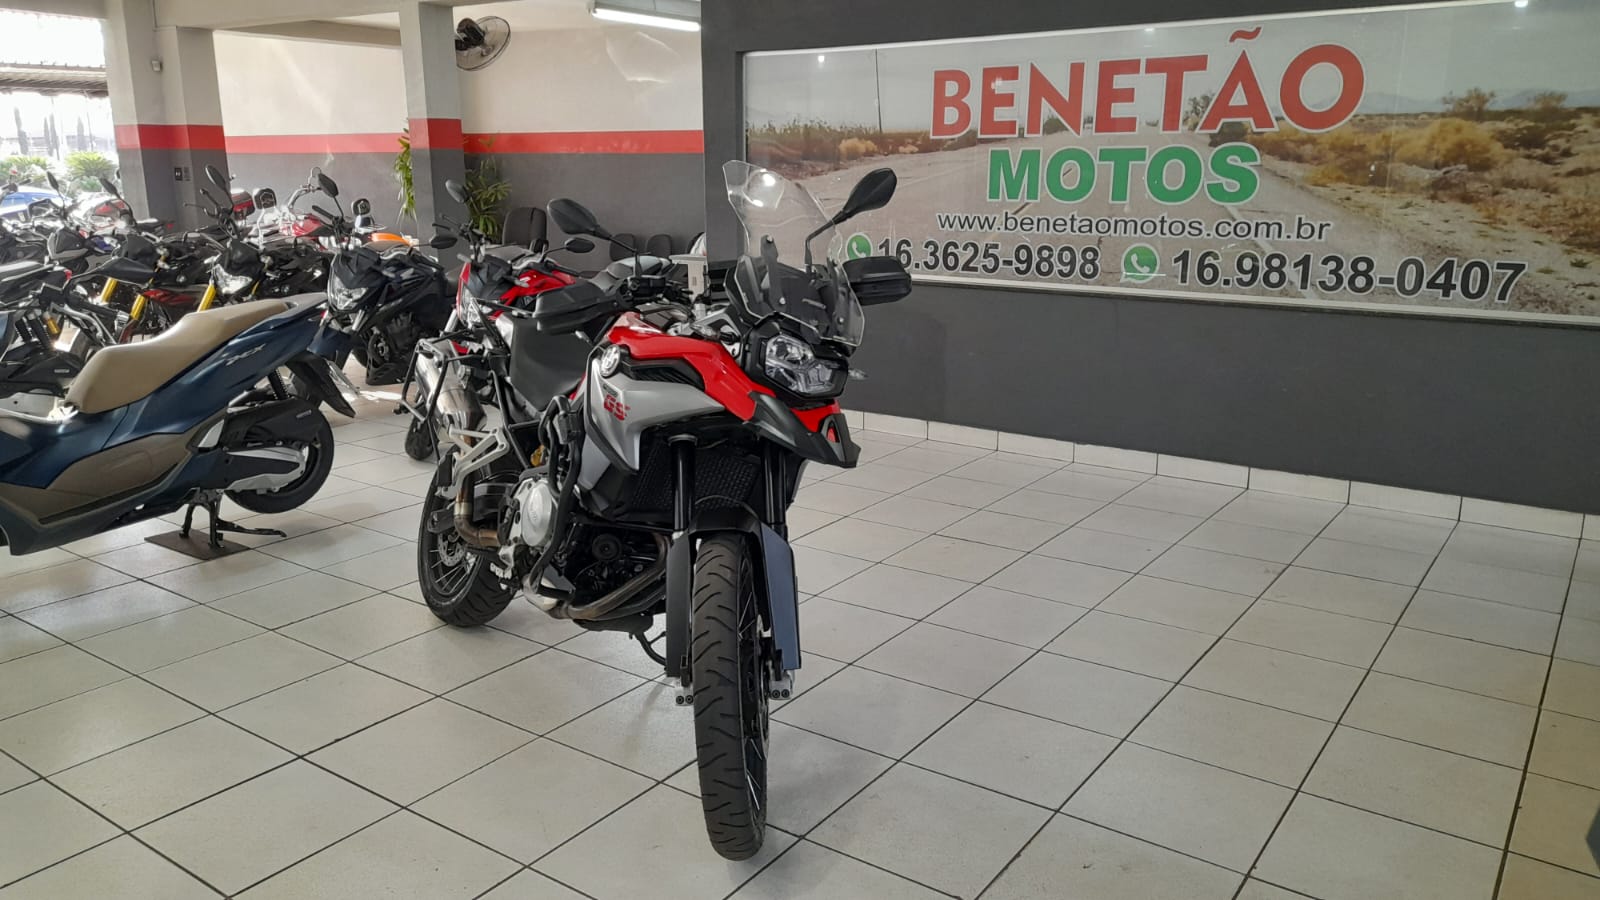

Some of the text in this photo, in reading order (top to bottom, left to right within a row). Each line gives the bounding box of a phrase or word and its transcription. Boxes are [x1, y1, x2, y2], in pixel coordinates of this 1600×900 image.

[931, 27, 1364, 137] BENETÃO
[987, 144, 1260, 203] MOTOS
[938, 212, 1330, 240] www.benetaomotos.com.br
[878, 238, 1526, 302] 16.3625-9898 16.98138-0407
[604, 394, 630, 420] GS
